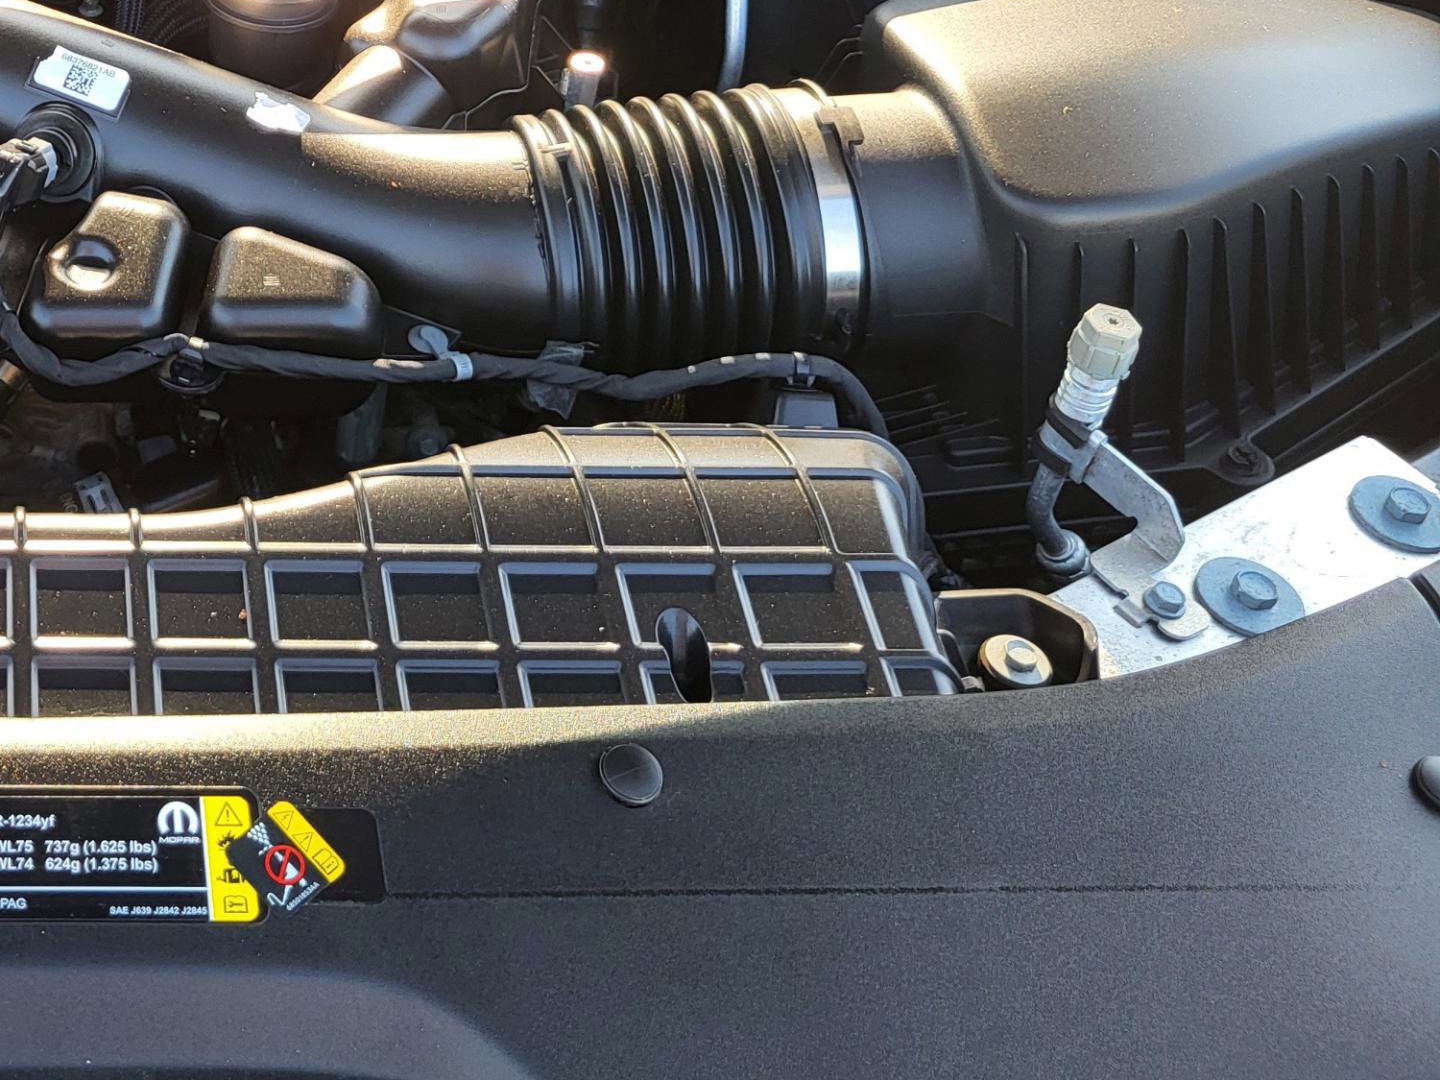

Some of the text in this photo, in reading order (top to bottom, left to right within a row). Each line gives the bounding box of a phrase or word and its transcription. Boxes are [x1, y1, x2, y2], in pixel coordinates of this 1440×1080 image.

[158, 836, 201, 844] MOPAR
[44, 840, 80, 856] 737g
[83, 839, 127, 856] (1.625
[129, 839, 158, 856] lbs)
[44, 857, 81, 873] 624g
[83, 857, 128, 873] (1.375
[130, 857, 159, 873] lbs)
[0, 898, 28, 910] PAG
[110, 906, 208, 915] SAE J639 J2842 J2845
